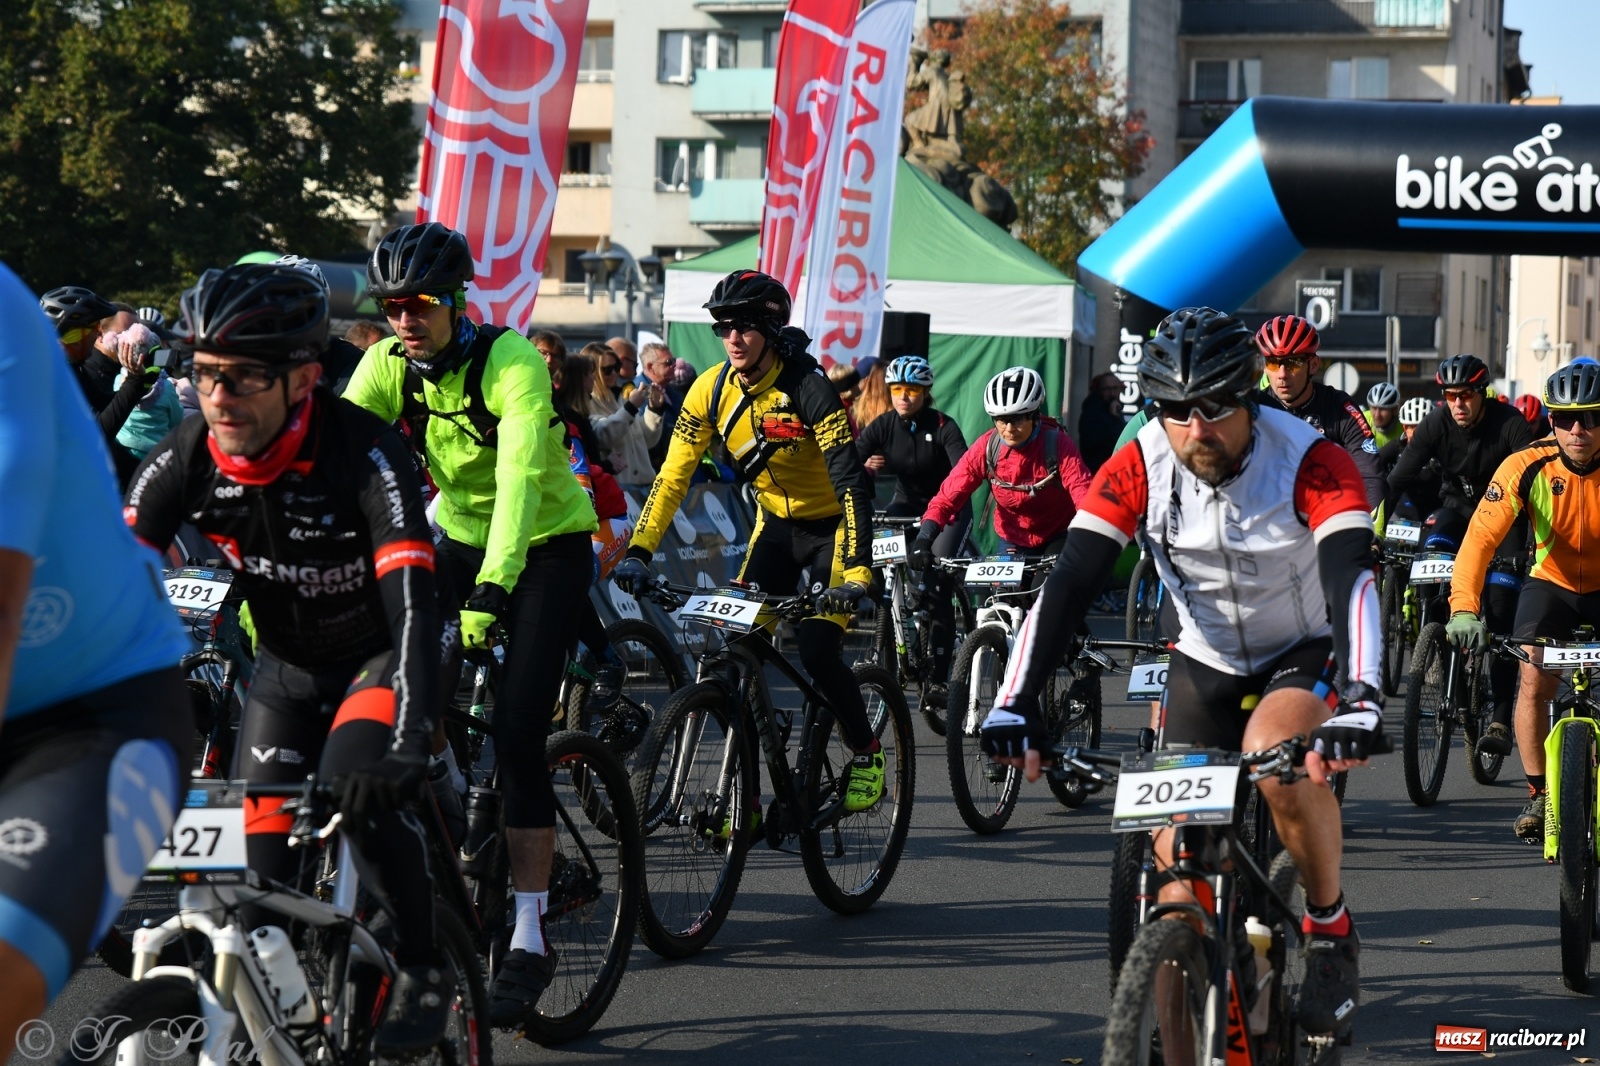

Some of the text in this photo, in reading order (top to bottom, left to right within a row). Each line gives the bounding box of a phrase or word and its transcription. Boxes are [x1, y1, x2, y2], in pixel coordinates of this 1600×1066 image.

[1395, 153, 1600, 213] bike at
[1302, 286, 1336, 297] SEKTOR
[1305, 296, 1331, 331] 0
[762, 412, 803, 428] SCS
[1387, 527, 1414, 538] 2177
[601, 527, 631, 561] GOMOLA
[872, 541, 899, 556] 2140
[976, 565, 1014, 577] 3075
[1421, 563, 1454, 575] 1126
[168, 583, 213, 603] 3191
[297, 575, 366, 598] SPORT
[693, 600, 746, 617] 2187
[1134, 776, 1213, 806] 2025
